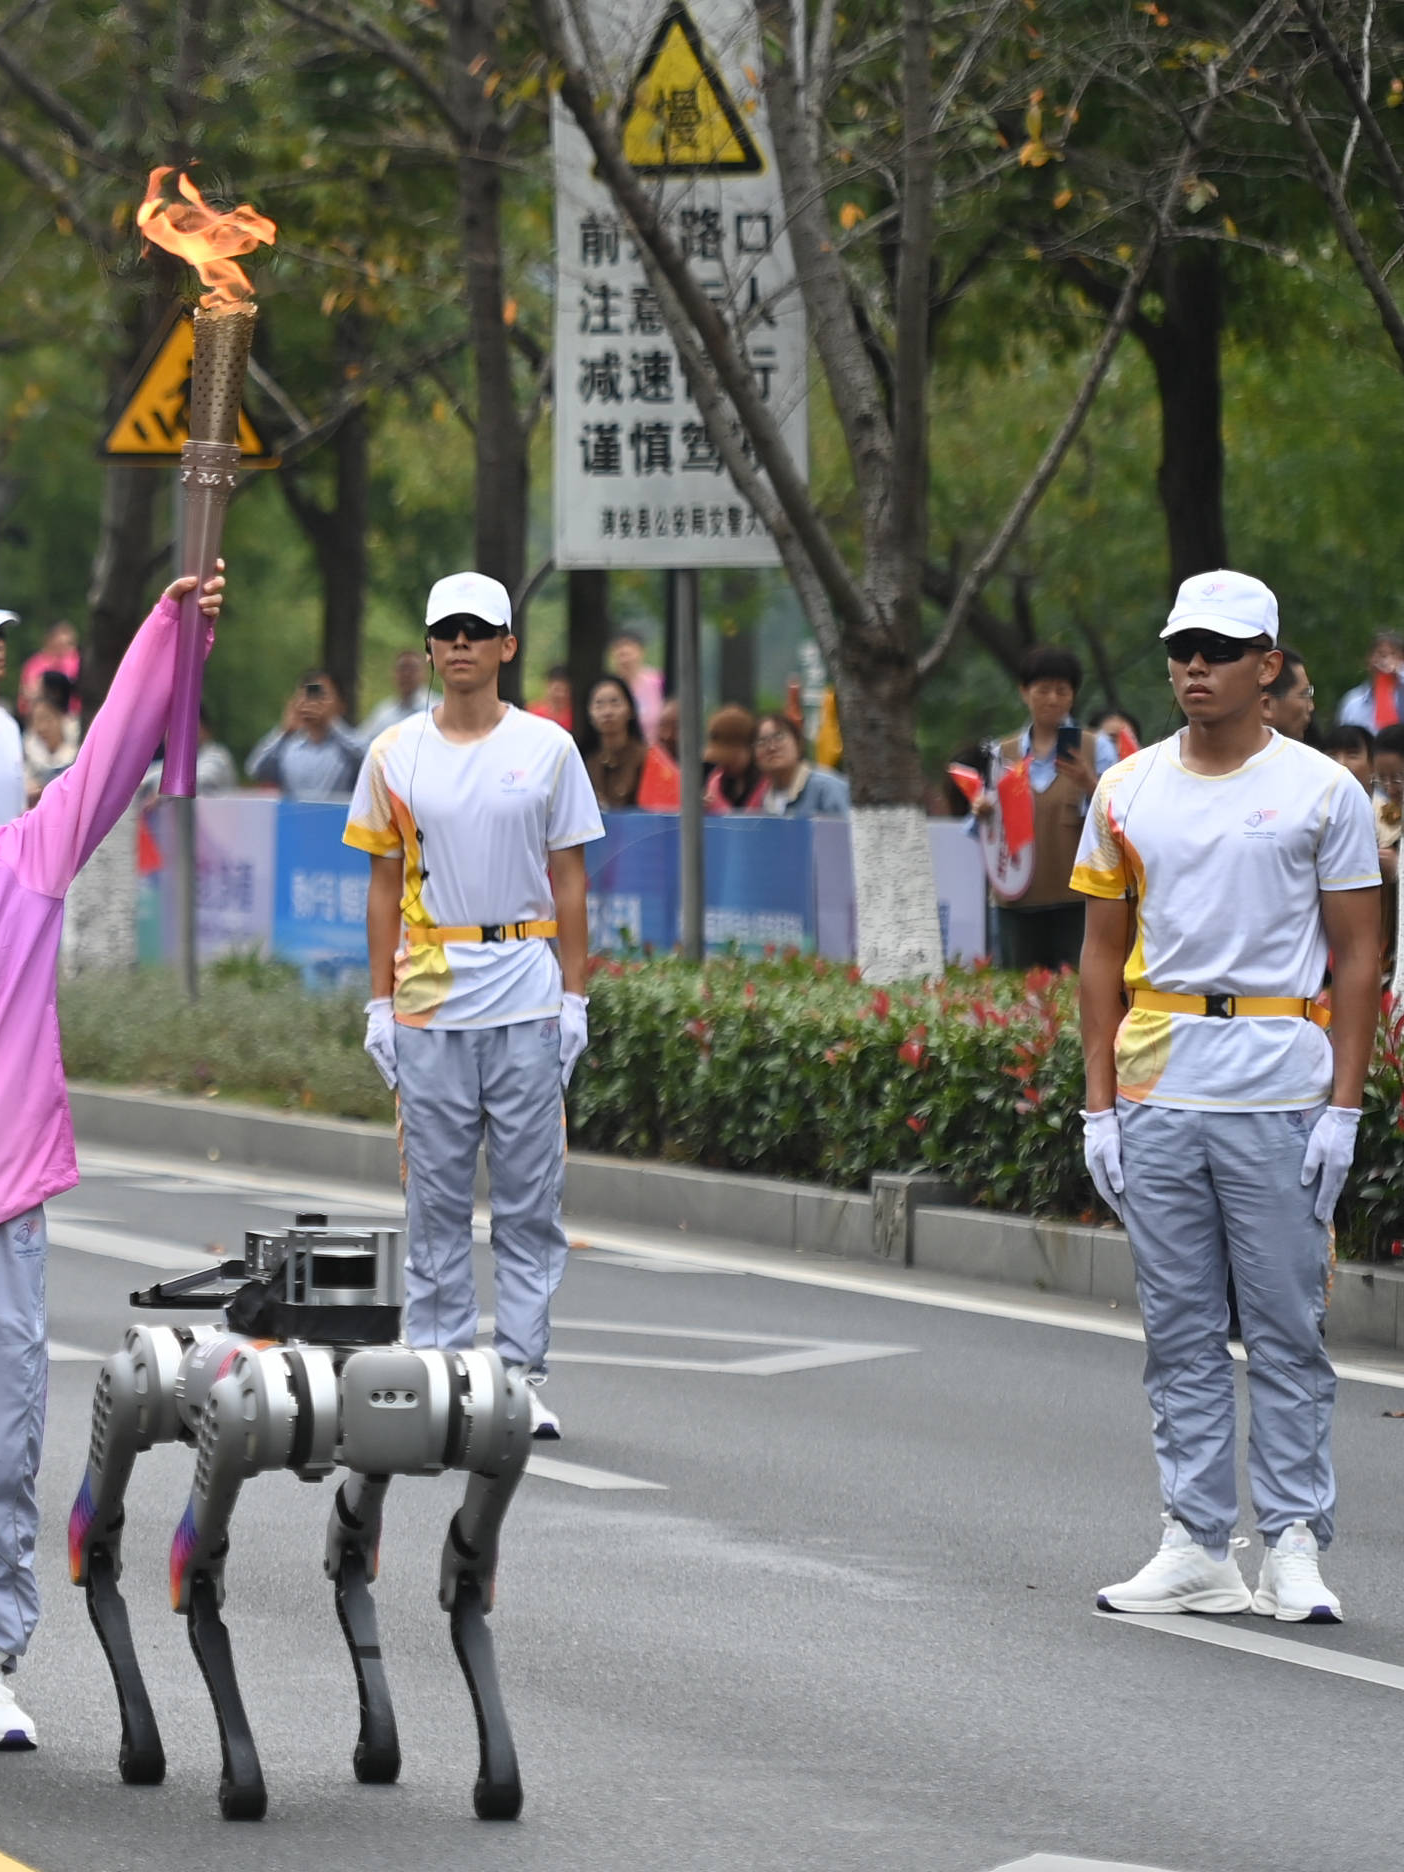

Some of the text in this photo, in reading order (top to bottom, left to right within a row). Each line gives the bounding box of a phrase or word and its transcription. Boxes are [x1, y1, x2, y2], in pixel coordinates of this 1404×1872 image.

[579, 209, 773, 265] 前路口
[578, 347, 778, 403] 减速行
[578, 422, 768, 476] 谨慎驾
